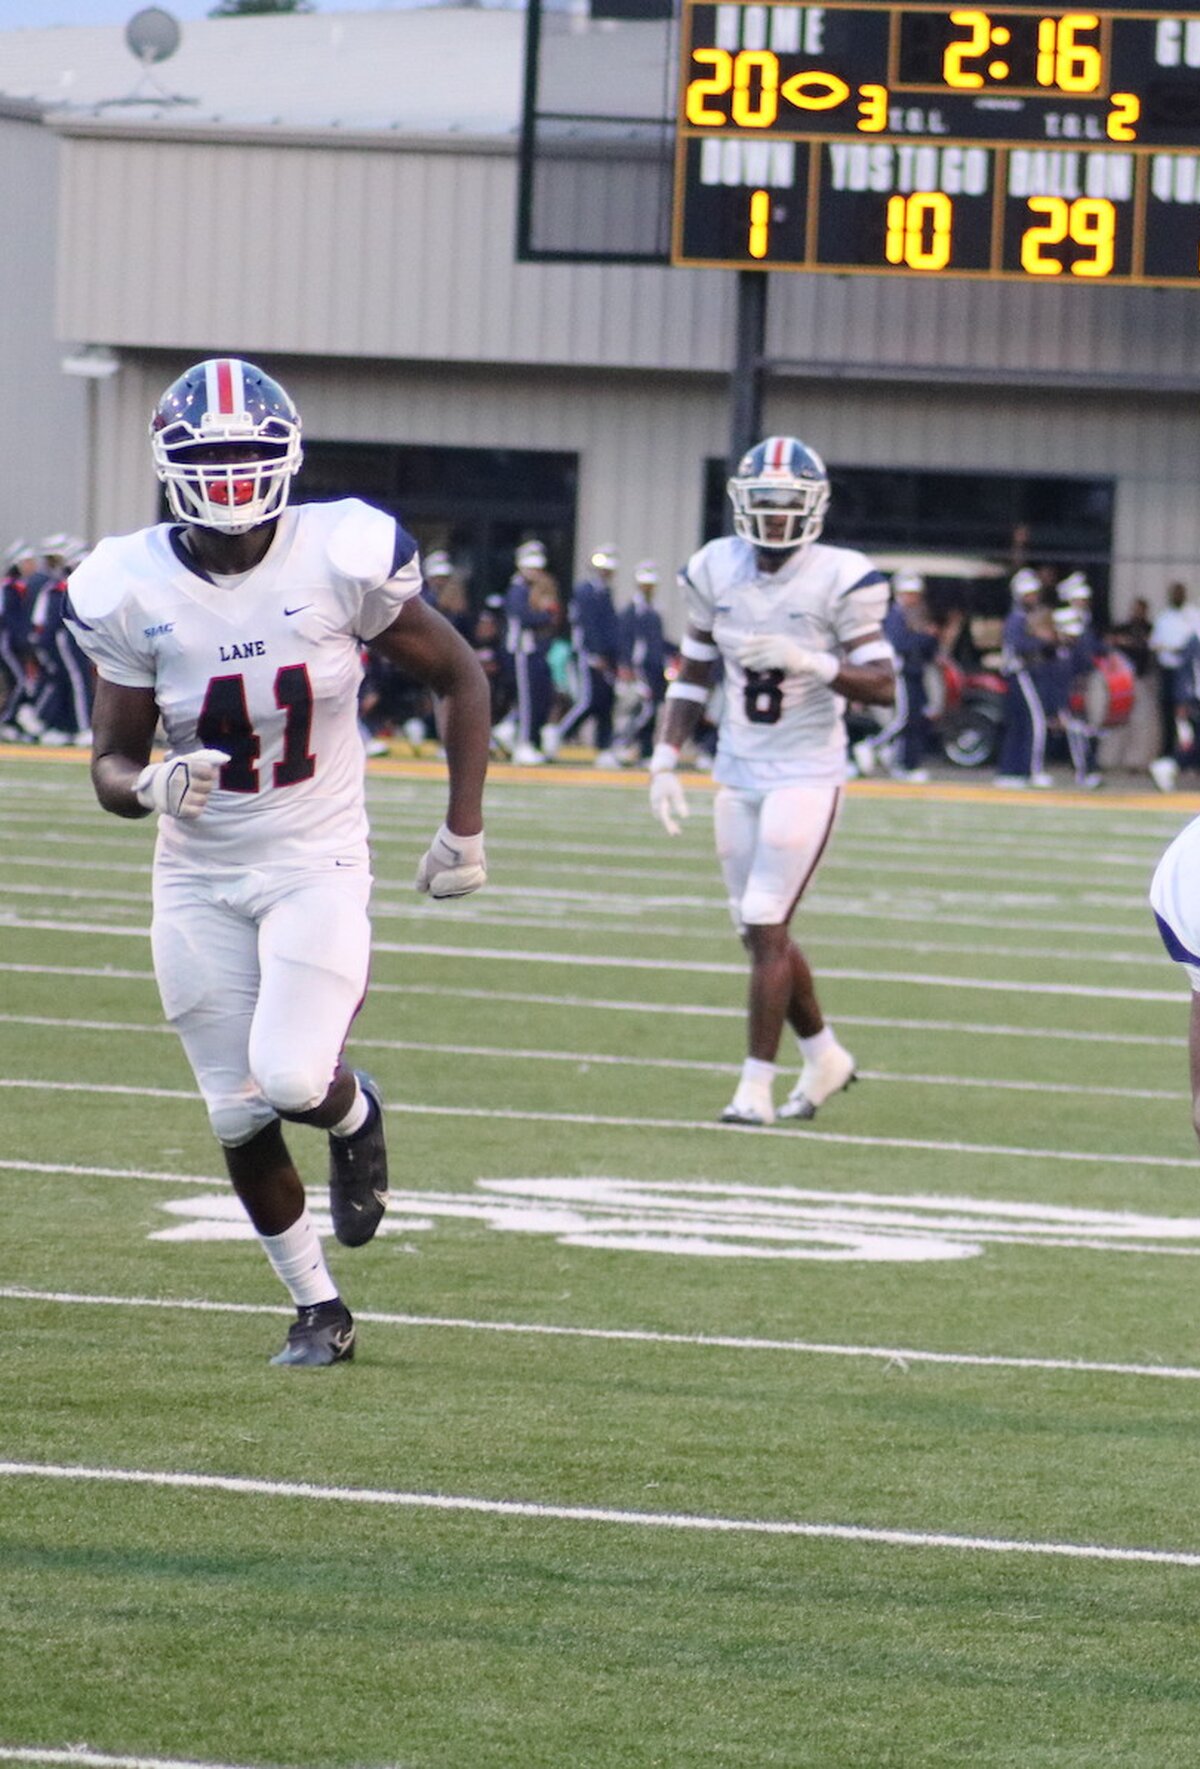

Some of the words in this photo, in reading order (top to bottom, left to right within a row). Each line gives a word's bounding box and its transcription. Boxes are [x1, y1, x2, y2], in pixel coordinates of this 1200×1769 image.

[943, 9, 1101, 92] 2:16
[686, 48, 779, 127] 20
[857, 84, 887, 132] 3
[1106, 93, 1140, 141] 2
[749, 190, 769, 258] 1
[885, 192, 952, 270] 10
[1021, 196, 1116, 276] 29
[220, 641, 266, 662] LANE
[196, 662, 316, 793] 41
[744, 667, 784, 724] 8
